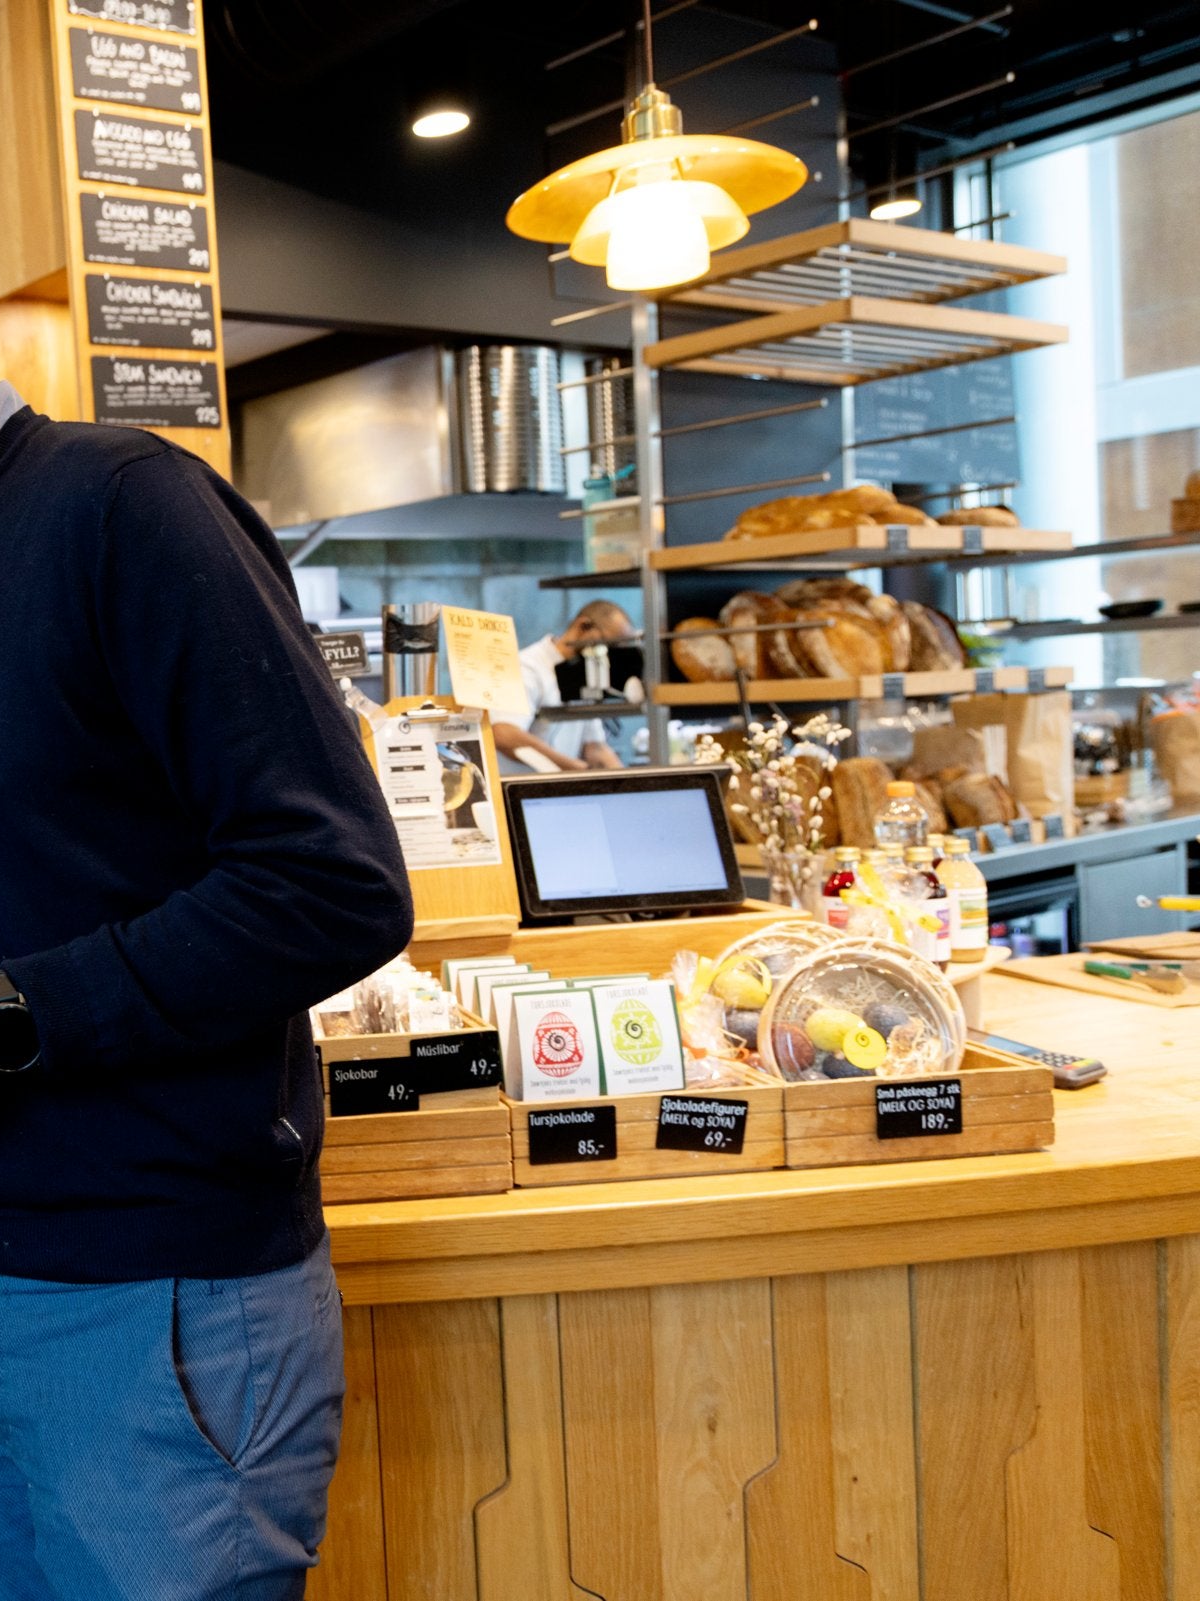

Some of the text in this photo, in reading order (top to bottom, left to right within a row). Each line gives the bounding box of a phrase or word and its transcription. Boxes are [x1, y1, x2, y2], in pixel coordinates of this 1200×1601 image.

[416, 1043, 461, 1057] Müslibar
[335, 1068, 378, 1083] Sjokobar
[877, 1083, 960, 1099] Små påskeegg 7 stk
[661, 1097, 748, 1117] Sjokoladefigurer
[878, 1096, 955, 1115] (MELK OG SOYA)
[529, 1111, 596, 1127] Tursjokolade
[661, 1111, 736, 1130] (MELK og SOYA)
